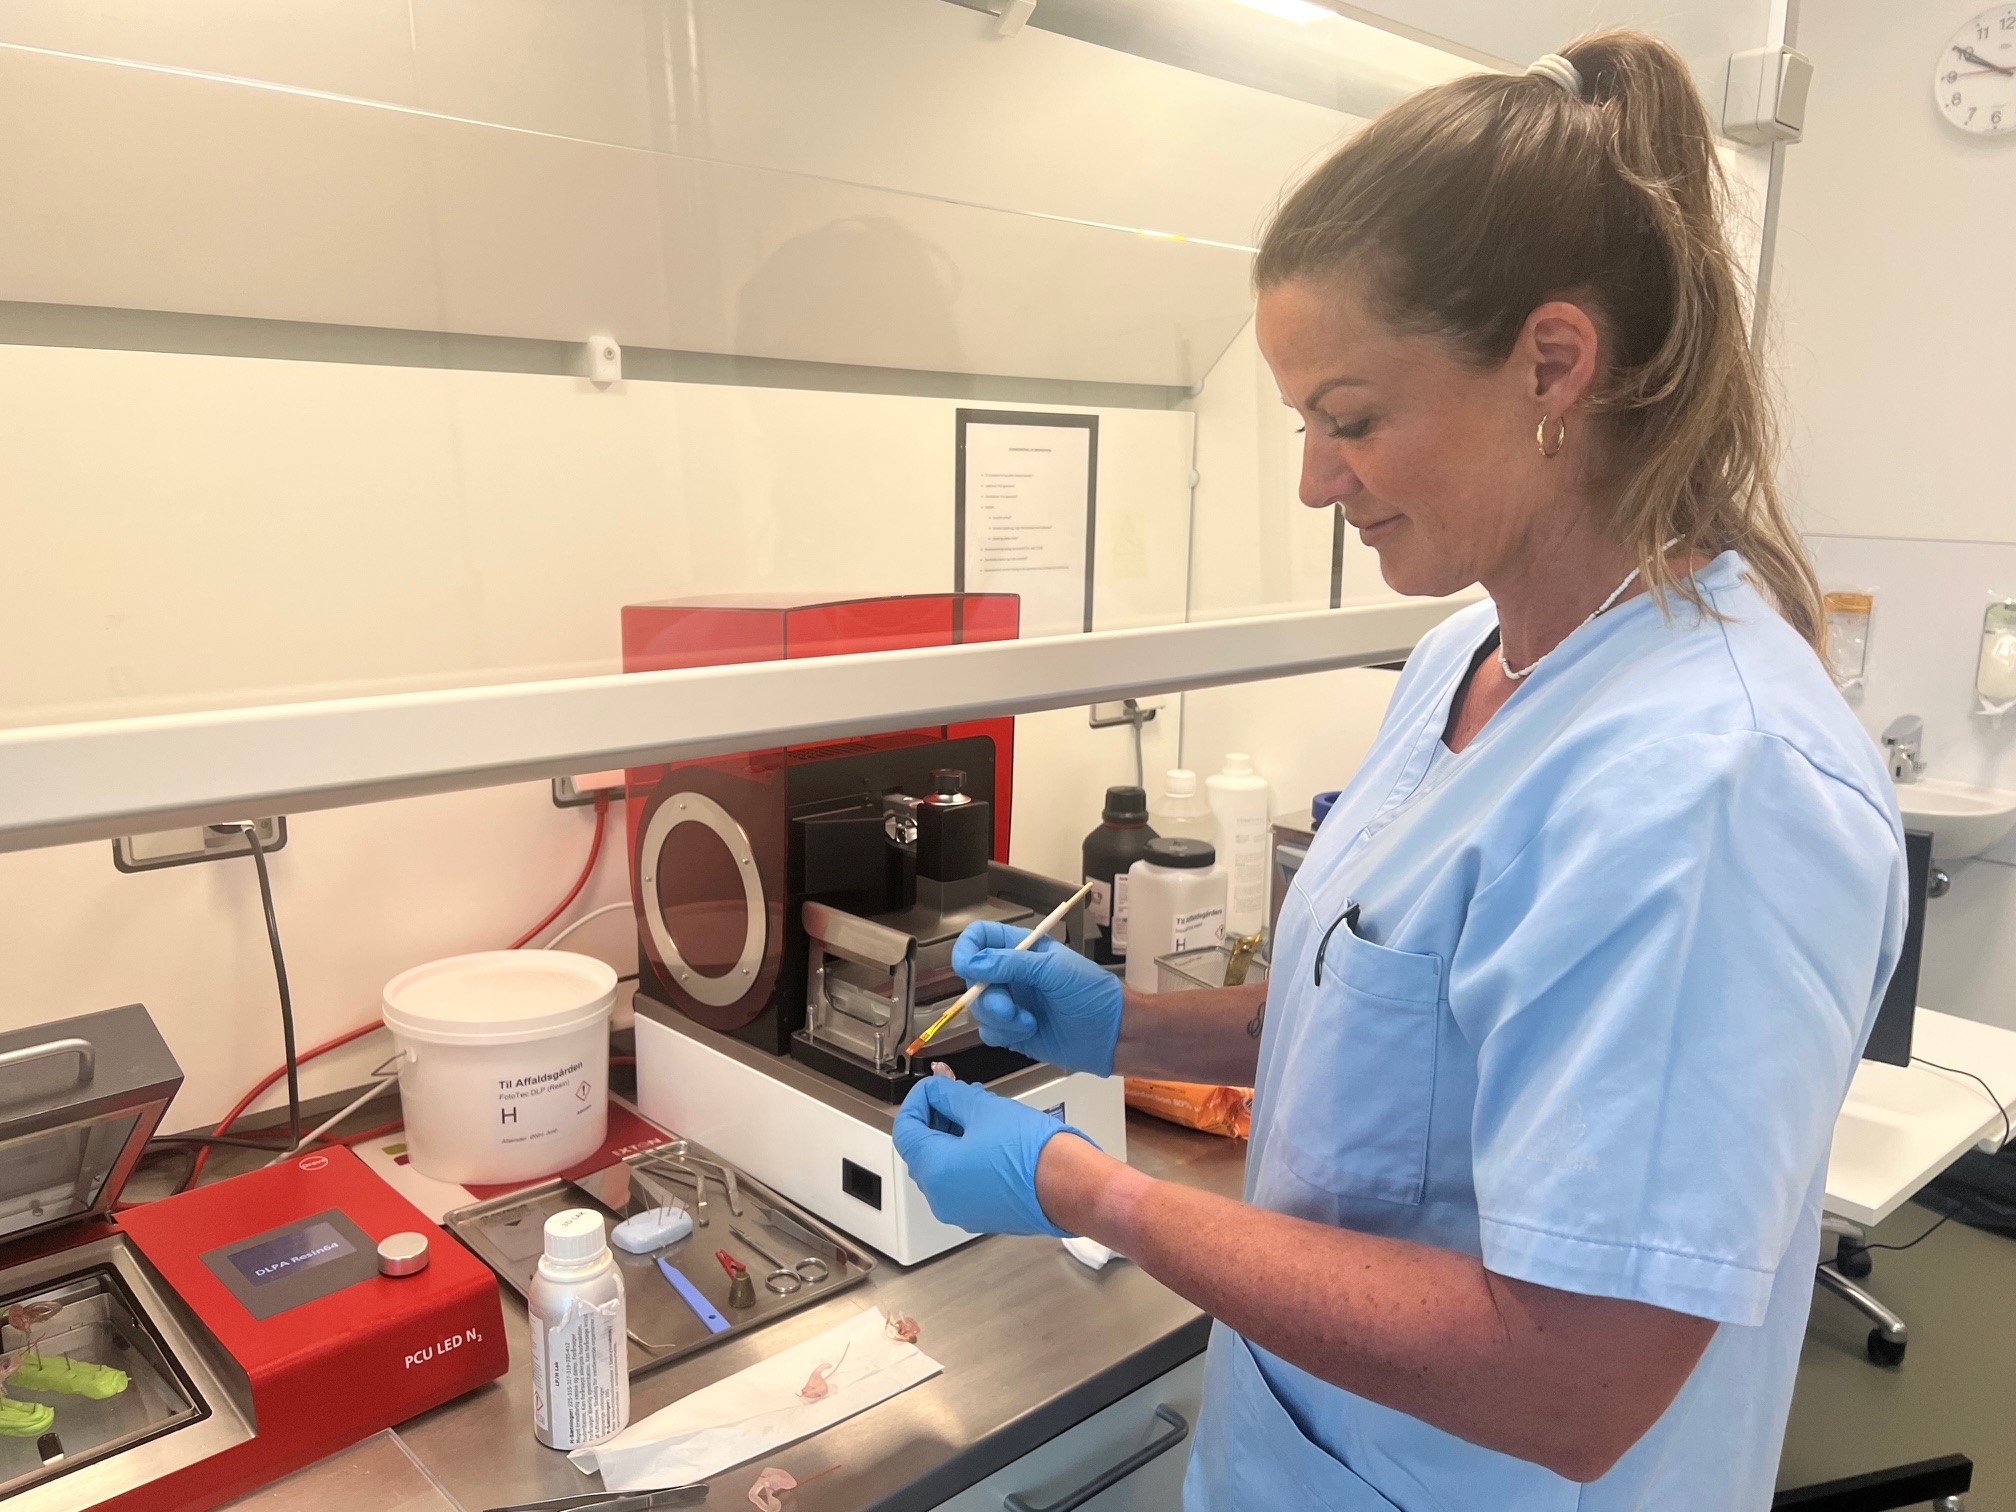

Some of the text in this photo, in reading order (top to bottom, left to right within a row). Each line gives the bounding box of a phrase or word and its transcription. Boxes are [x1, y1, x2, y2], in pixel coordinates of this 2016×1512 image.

[1976, 27, 1989, 40] 11
[1952, 92, 1962, 106] 8
[1968, 107, 1977, 121] 7
[1991, 110, 2002, 124] 6
[499, 1062, 583, 1090] Til Affaldsgården
[499, 1091, 529, 1100] FotoTec
[530, 1086, 546, 1096] DLP
[502, 1106, 517, 1124] H
[255, 1242, 338, 1276] DLPA Resin64
[404, 1346, 433, 1369] PCU
[436, 1334, 462, 1355] LED
